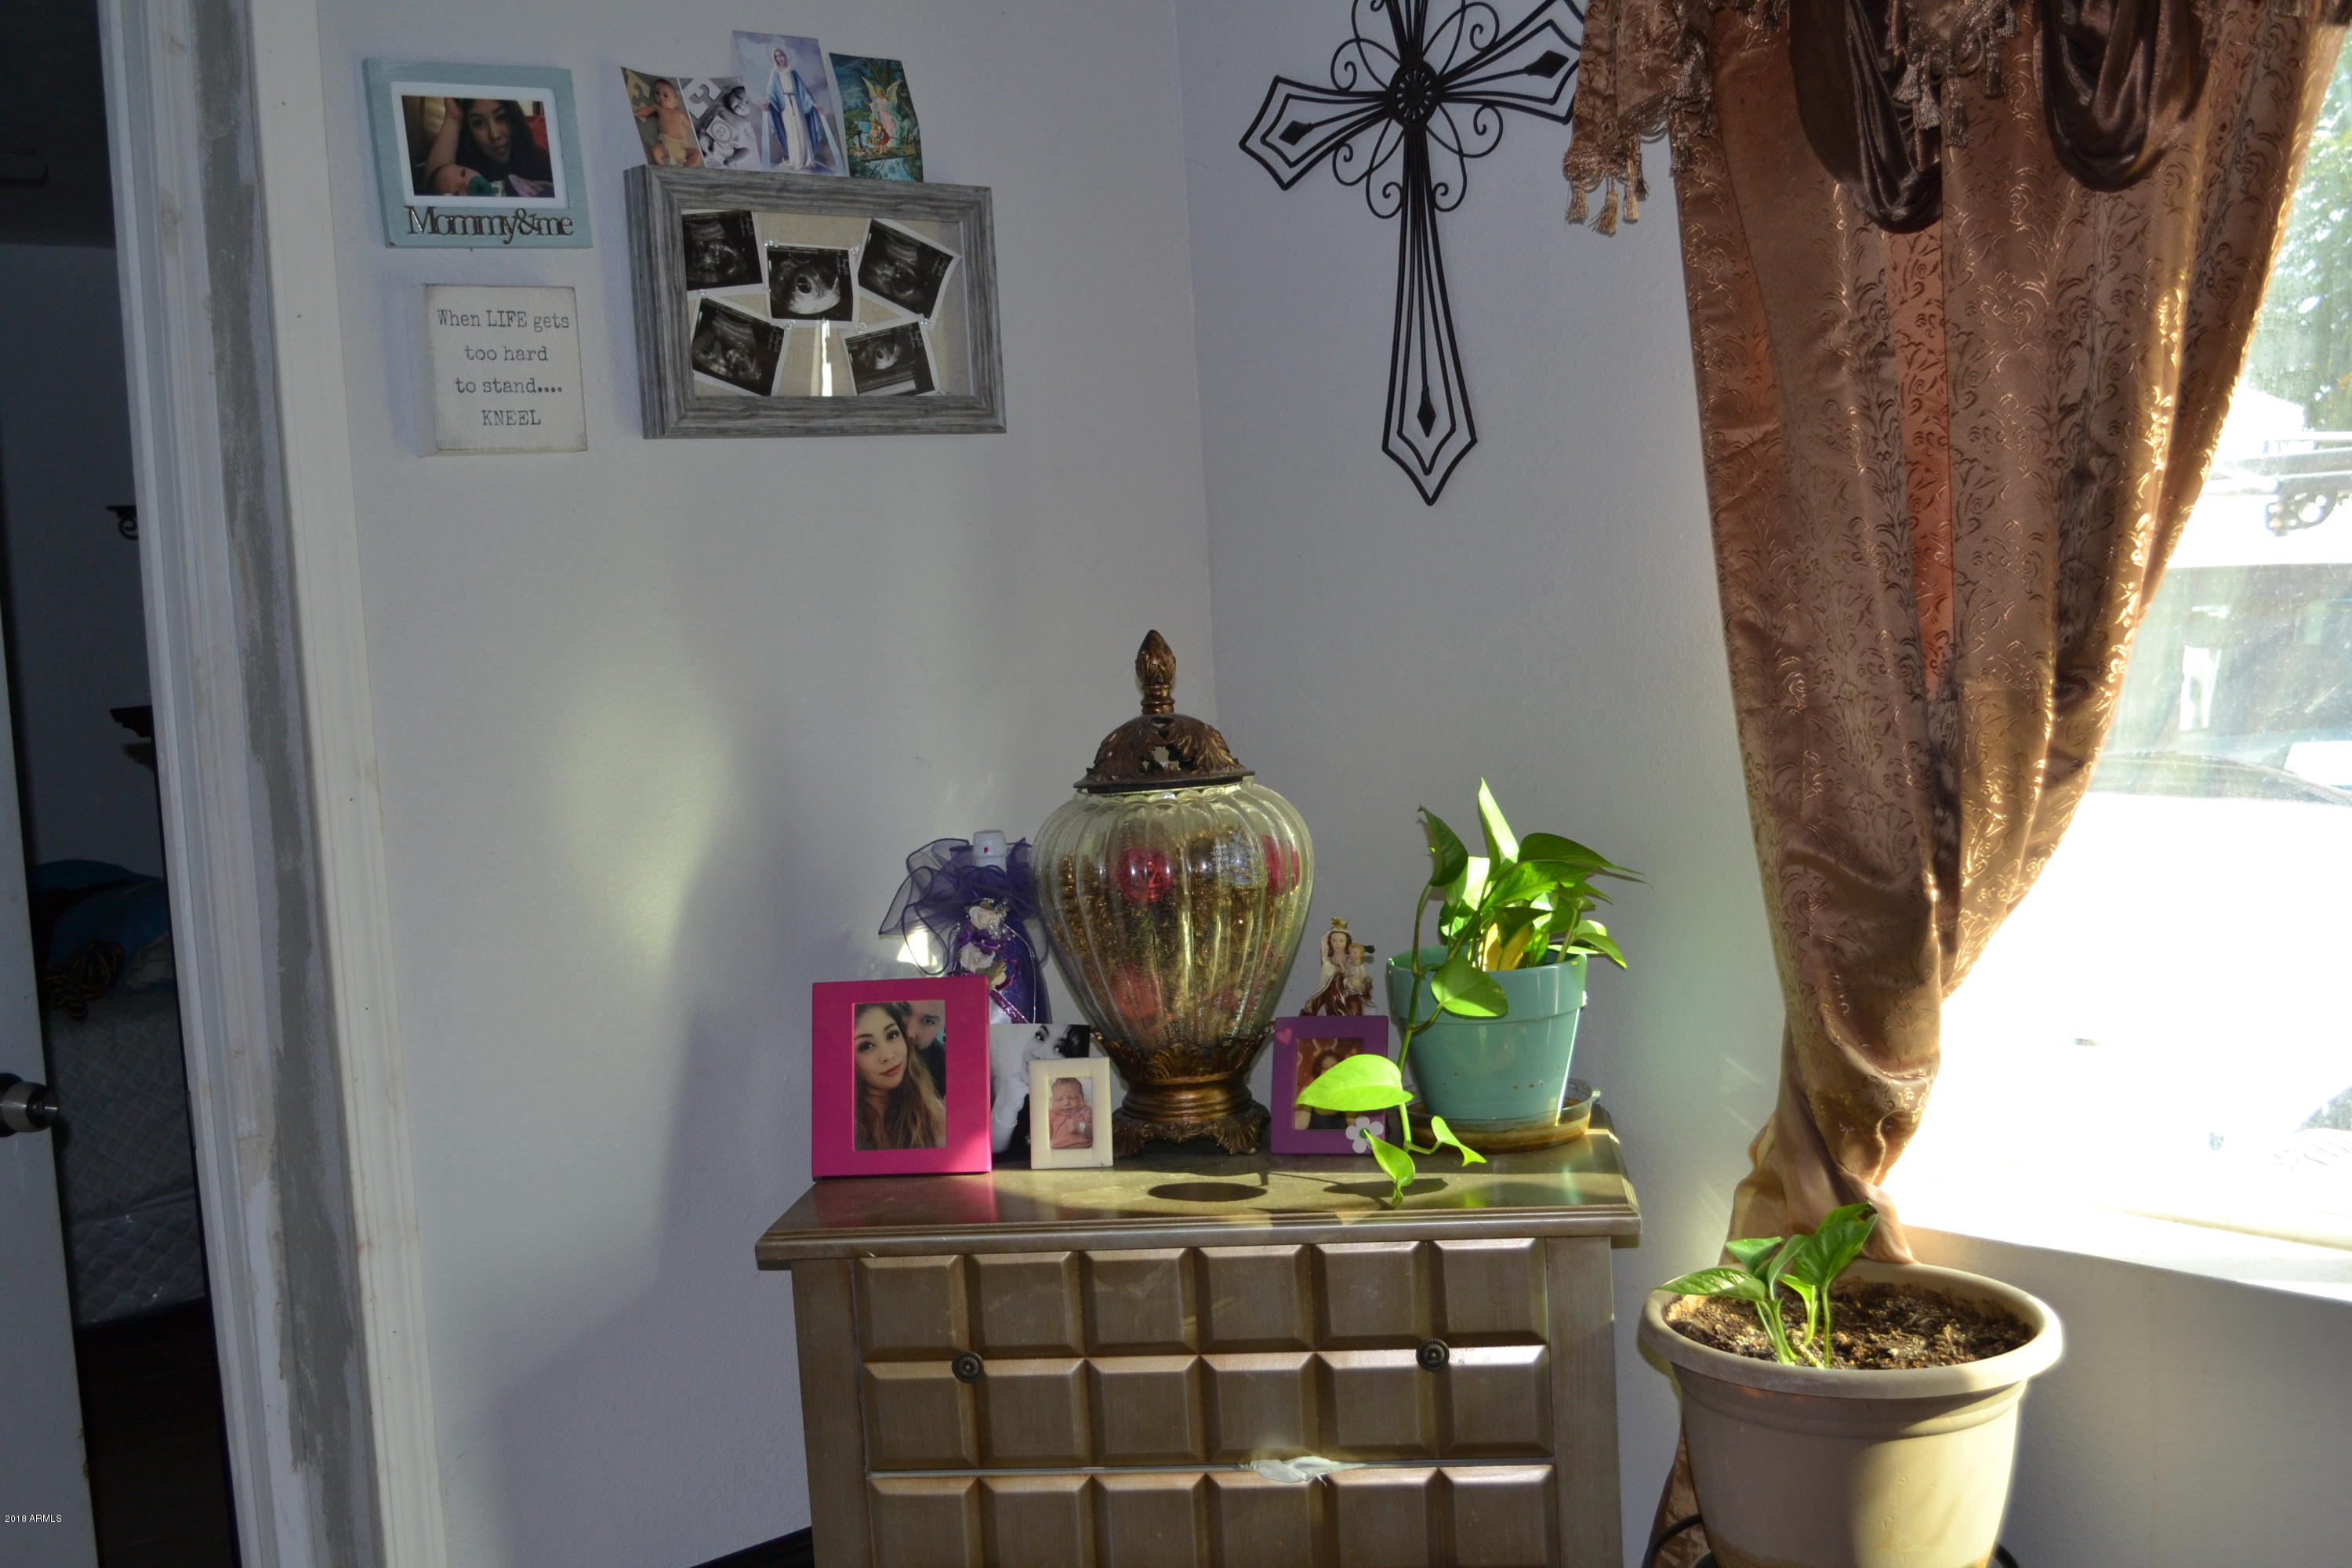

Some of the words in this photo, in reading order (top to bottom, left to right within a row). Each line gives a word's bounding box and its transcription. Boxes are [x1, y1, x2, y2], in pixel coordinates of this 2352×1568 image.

[437, 309, 481, 328] When
[486, 310, 527, 328] LIFE
[533, 313, 570, 333] gets
[464, 344, 497, 361] too
[503, 345, 549, 361] hard
[455, 377, 477, 394] to
[481, 409, 542, 426] KNEEL
